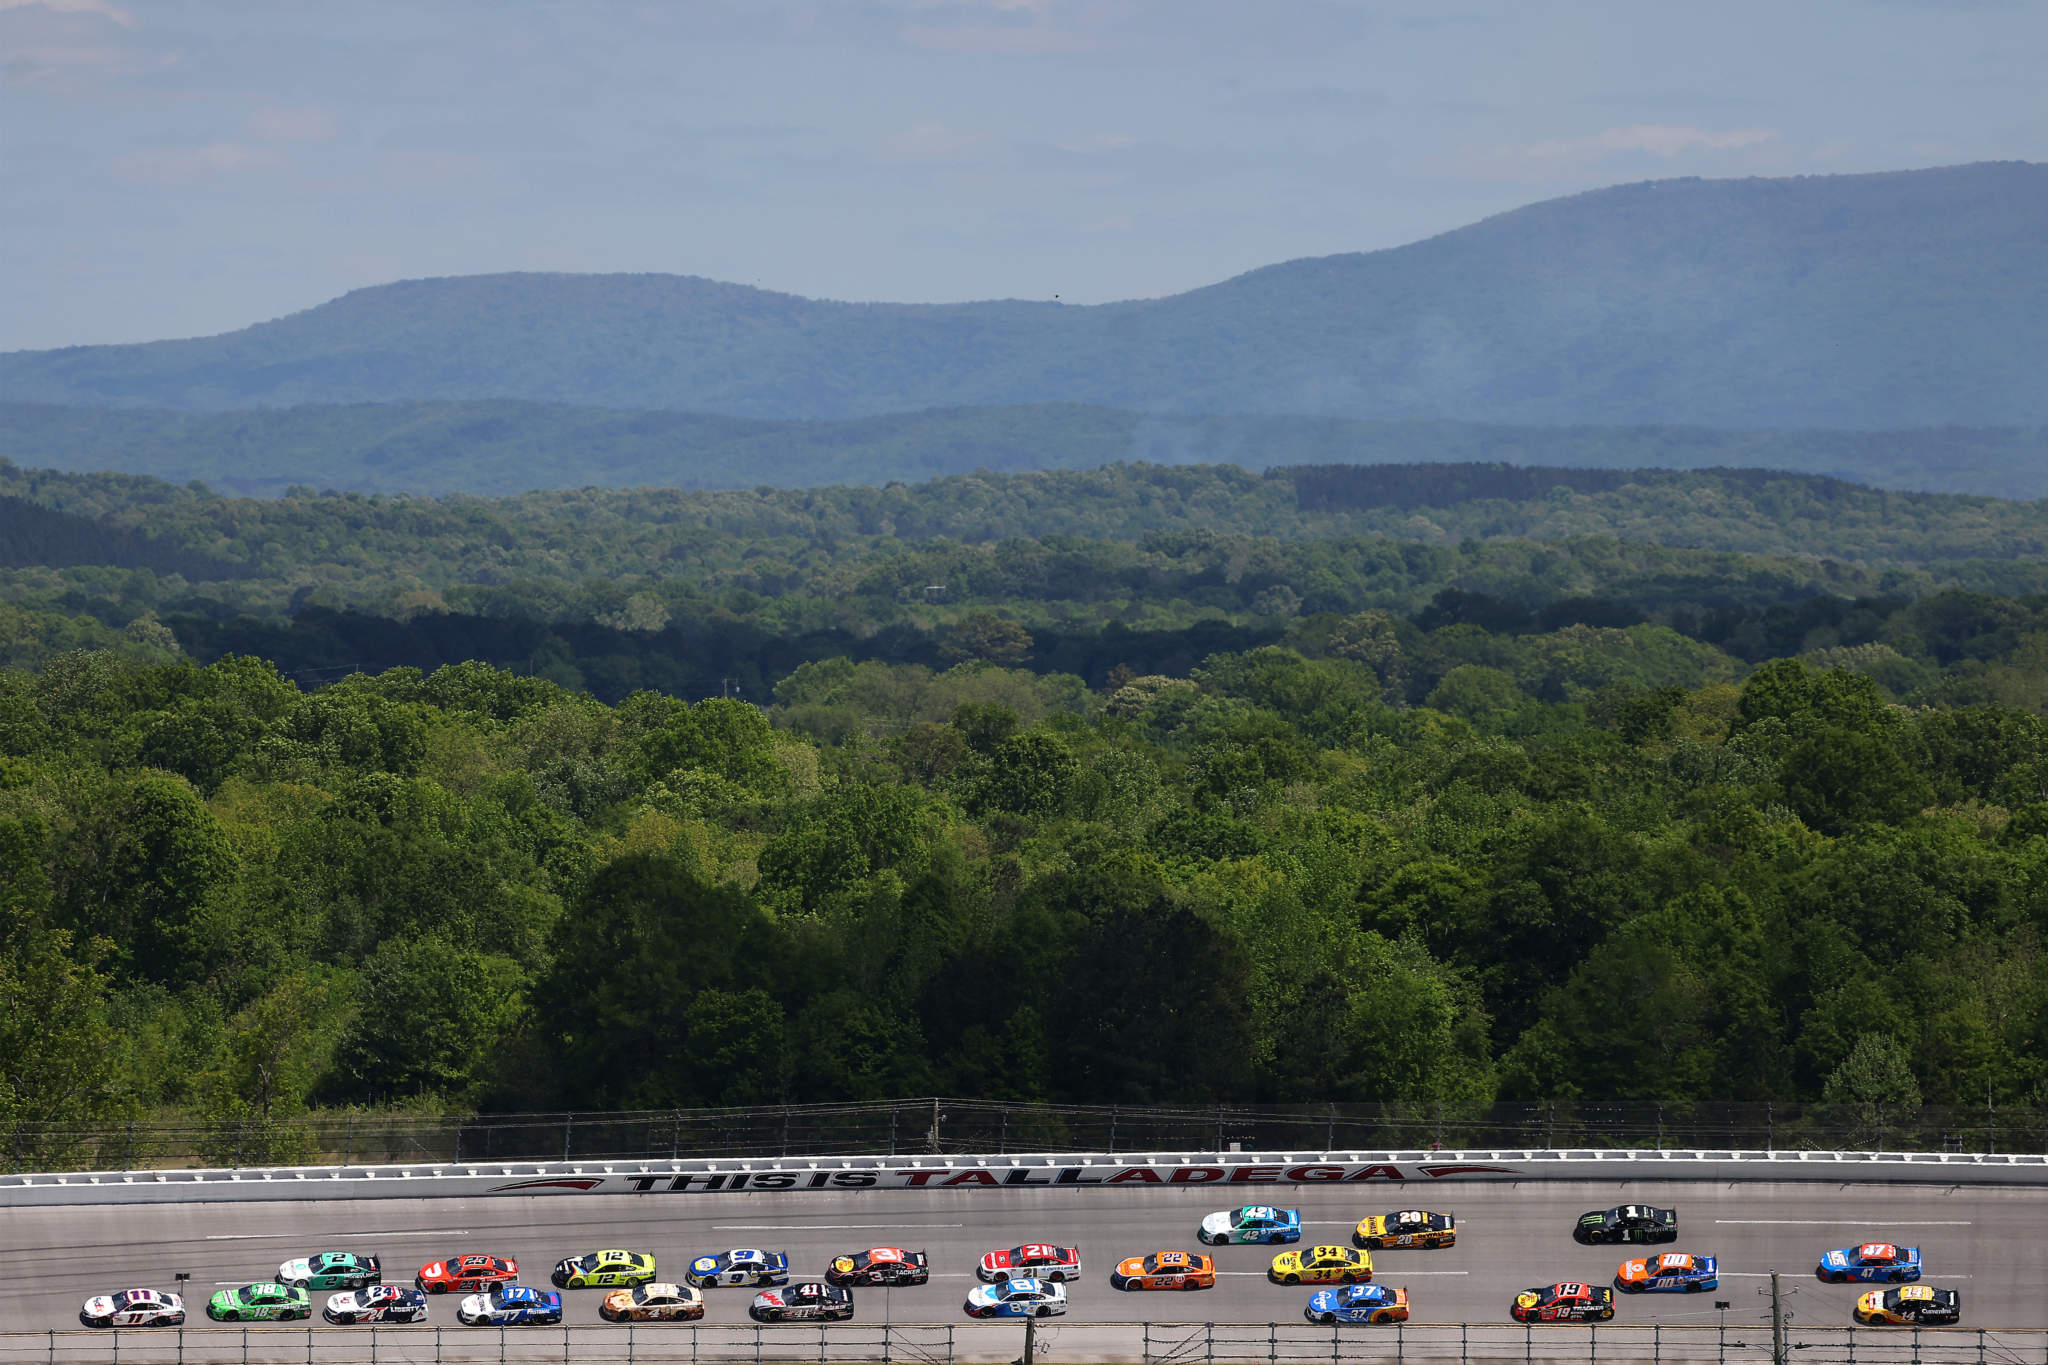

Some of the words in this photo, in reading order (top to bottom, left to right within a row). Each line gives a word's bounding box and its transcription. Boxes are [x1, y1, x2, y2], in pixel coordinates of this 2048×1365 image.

[624, 1172, 800, 1190] THIS
[808, 1171, 880, 1188] IS
[895, 1164, 1405, 1186] TALLADEGA
[1244, 1207, 1268, 1218] 42
[1626, 1205, 1639, 1218] 1
[1399, 1212, 1421, 1223] 20
[1242, 1231, 1260, 1241] 42
[1396, 1235, 1414, 1245] 20
[1622, 1229, 1631, 1241] 1
[734, 1250, 755, 1261] 9
[871, 1248, 898, 1260] 3
[1025, 1245, 1048, 1256] 21
[1317, 1247, 1338, 1258] 34
[1863, 1244, 1887, 1256] 47
[332, 1253, 346, 1262] 2
[463, 1256, 489, 1266] 23
[604, 1252, 624, 1262] 12
[1163, 1253, 1182, 1263] 22
[1662, 1254, 1689, 1266] 00
[597, 1273, 616, 1284] 12
[729, 1273, 744, 1283] 9
[869, 1271, 884, 1281] 3
[1023, 1268, 1038, 1278] 21
[1313, 1270, 1332, 1280] 34
[1861, 1268, 1875, 1278] 47
[324, 1276, 338, 1286] 2
[458, 1279, 477, 1290] 23
[1010, 1280, 1029, 1290] 8
[1154, 1276, 1174, 1287] 22
[1656, 1278, 1675, 1288] 00
[130, 1290, 151, 1300] 11
[256, 1284, 277, 1295] 18
[373, 1287, 392, 1298] 24
[508, 1288, 526, 1299] 17
[800, 1283, 819, 1296] 41
[1352, 1285, 1377, 1297] 37
[1559, 1284, 1580, 1296] 19
[1903, 1287, 1924, 1298] 14
[254, 1307, 270, 1317] 18
[648, 1308, 660, 1318] 4
[1010, 1302, 1023, 1313] 8
[1555, 1307, 1571, 1318] 19
[1921, 1306, 1952, 1315] Cummins
[128, 1313, 144, 1323] 11
[368, 1309, 385, 1320] 24
[503, 1311, 520, 1321] 17
[1350, 1309, 1366, 1319] 37
[1901, 1311, 1916, 1321] 14
